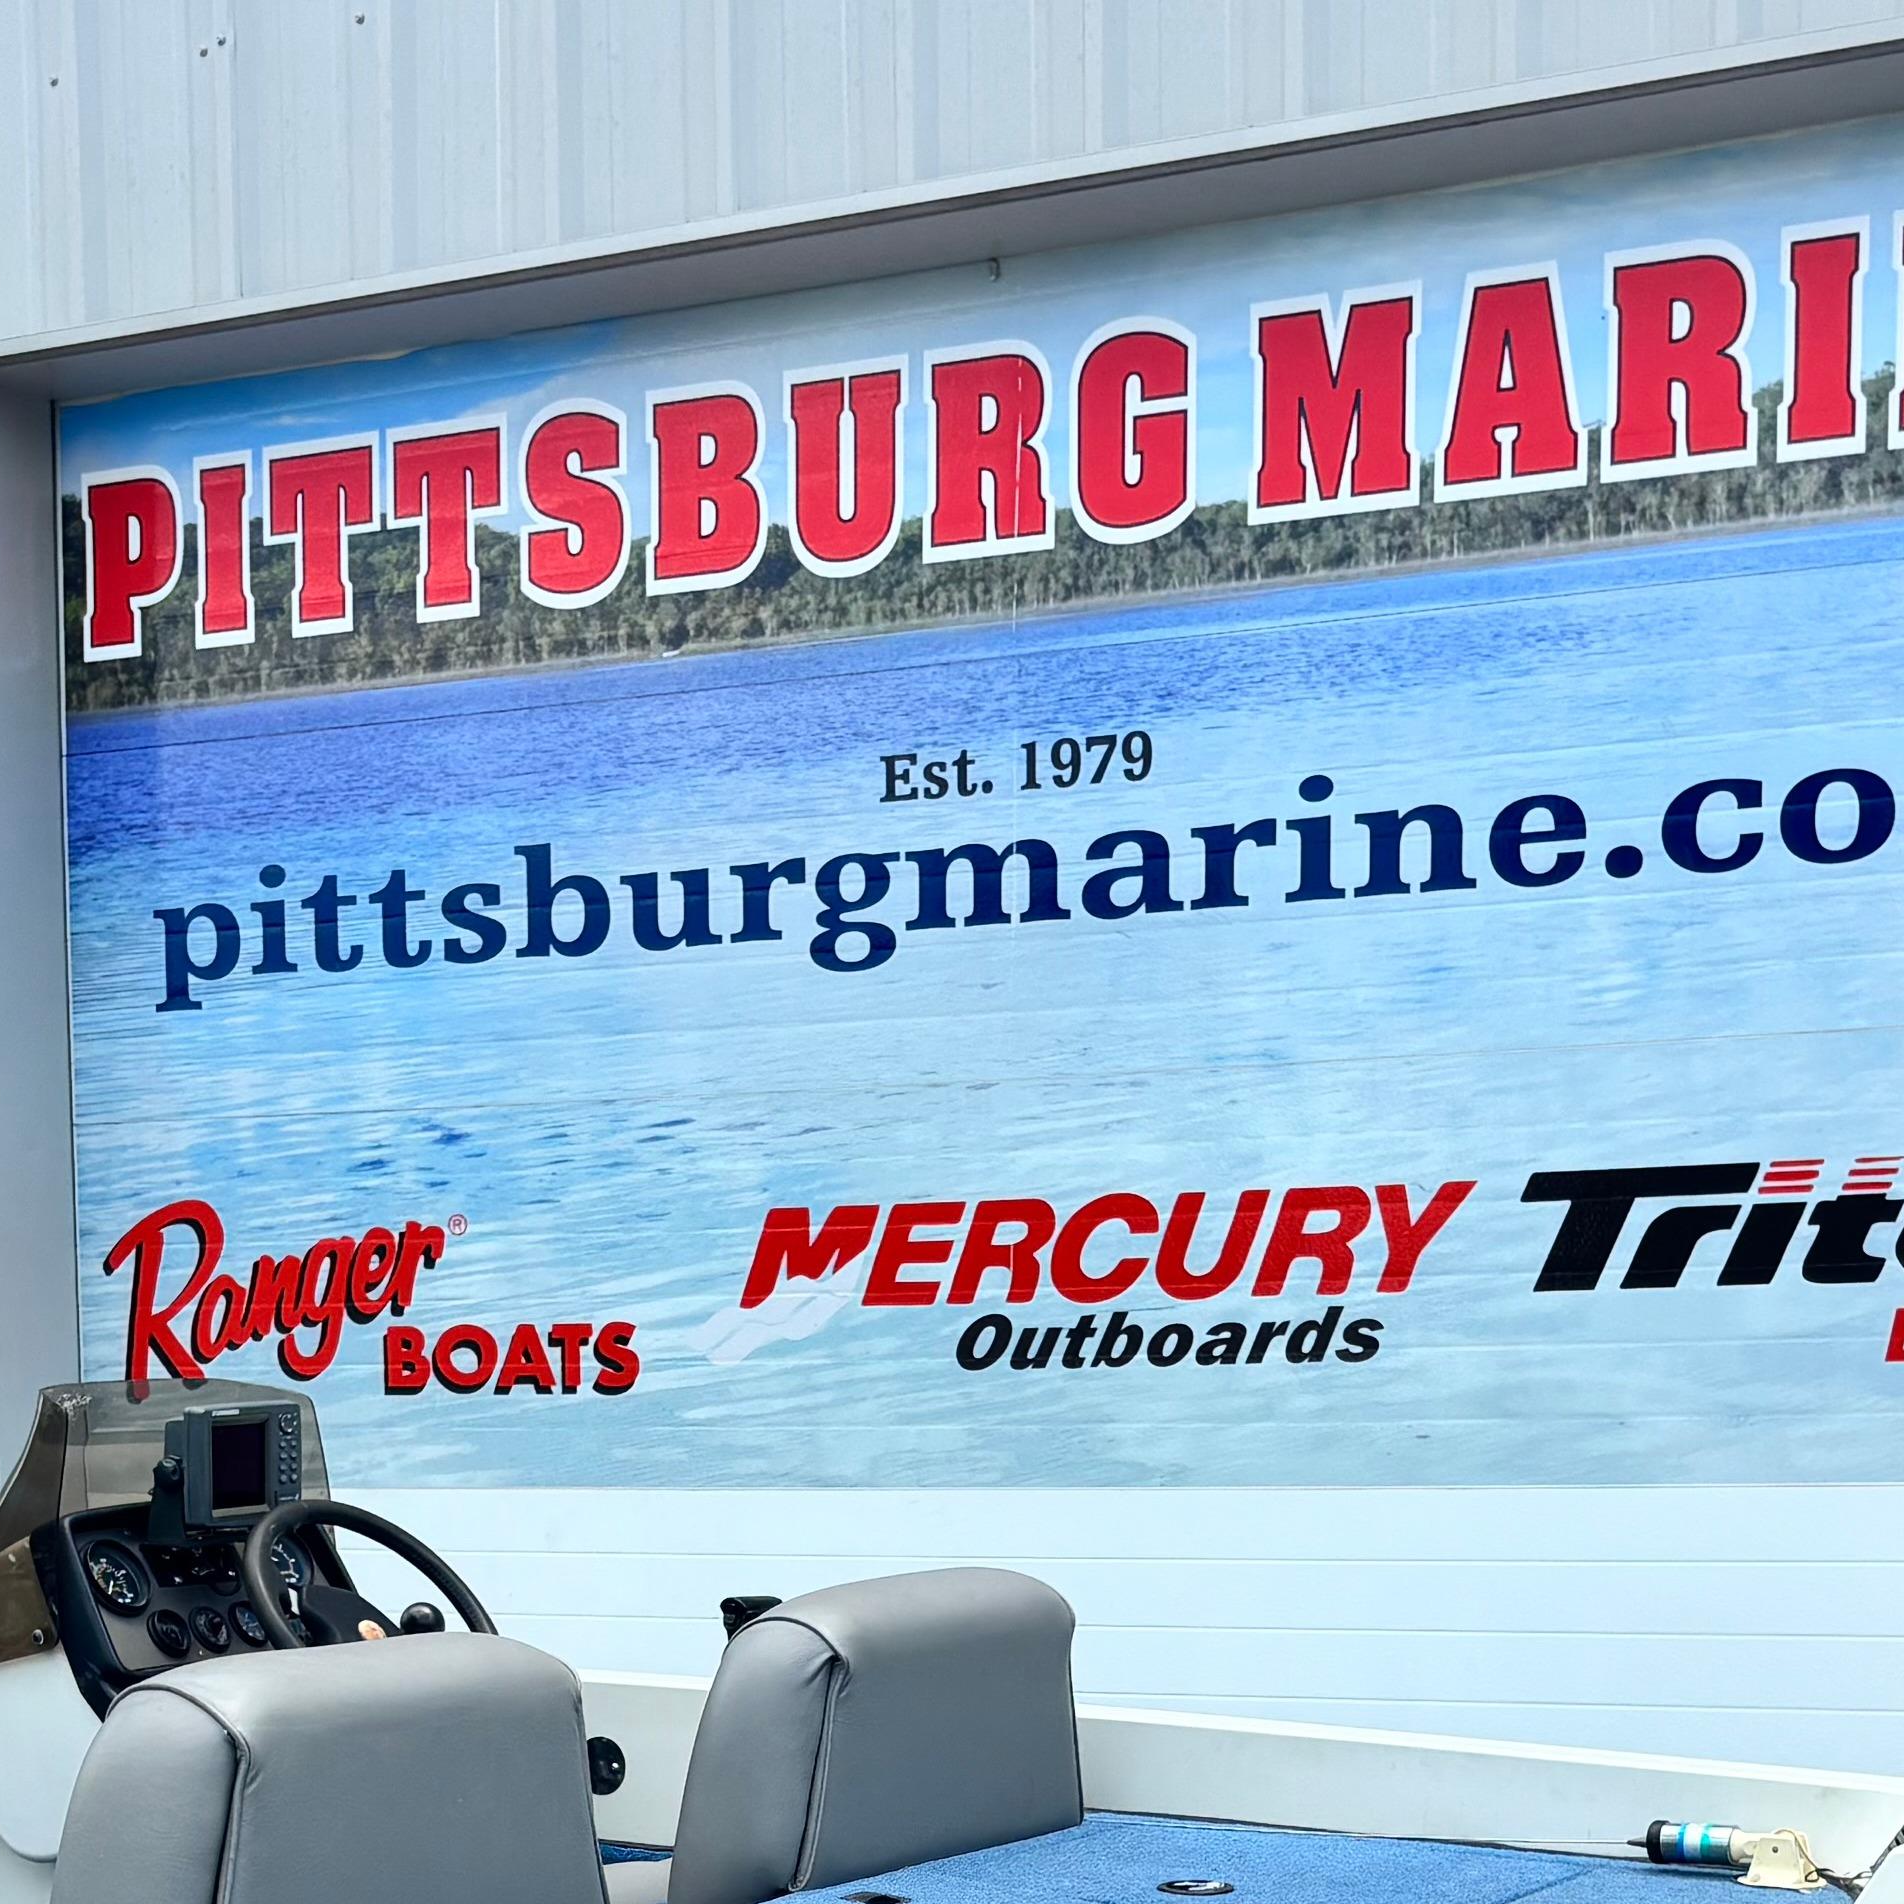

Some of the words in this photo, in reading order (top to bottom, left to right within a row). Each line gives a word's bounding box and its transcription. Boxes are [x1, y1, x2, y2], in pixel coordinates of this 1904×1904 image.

[84, 318, 1195, 660] PITTSBURG
[879, 754, 995, 803] Est.
[1018, 730, 1154, 792] 1979
[738, 1180, 1479, 1309] MERCURY
[103, 1198, 447, 1403] Ranger
[954, 1305, 1385, 1372] Outboards
[384, 1321, 641, 1396] BOATS
